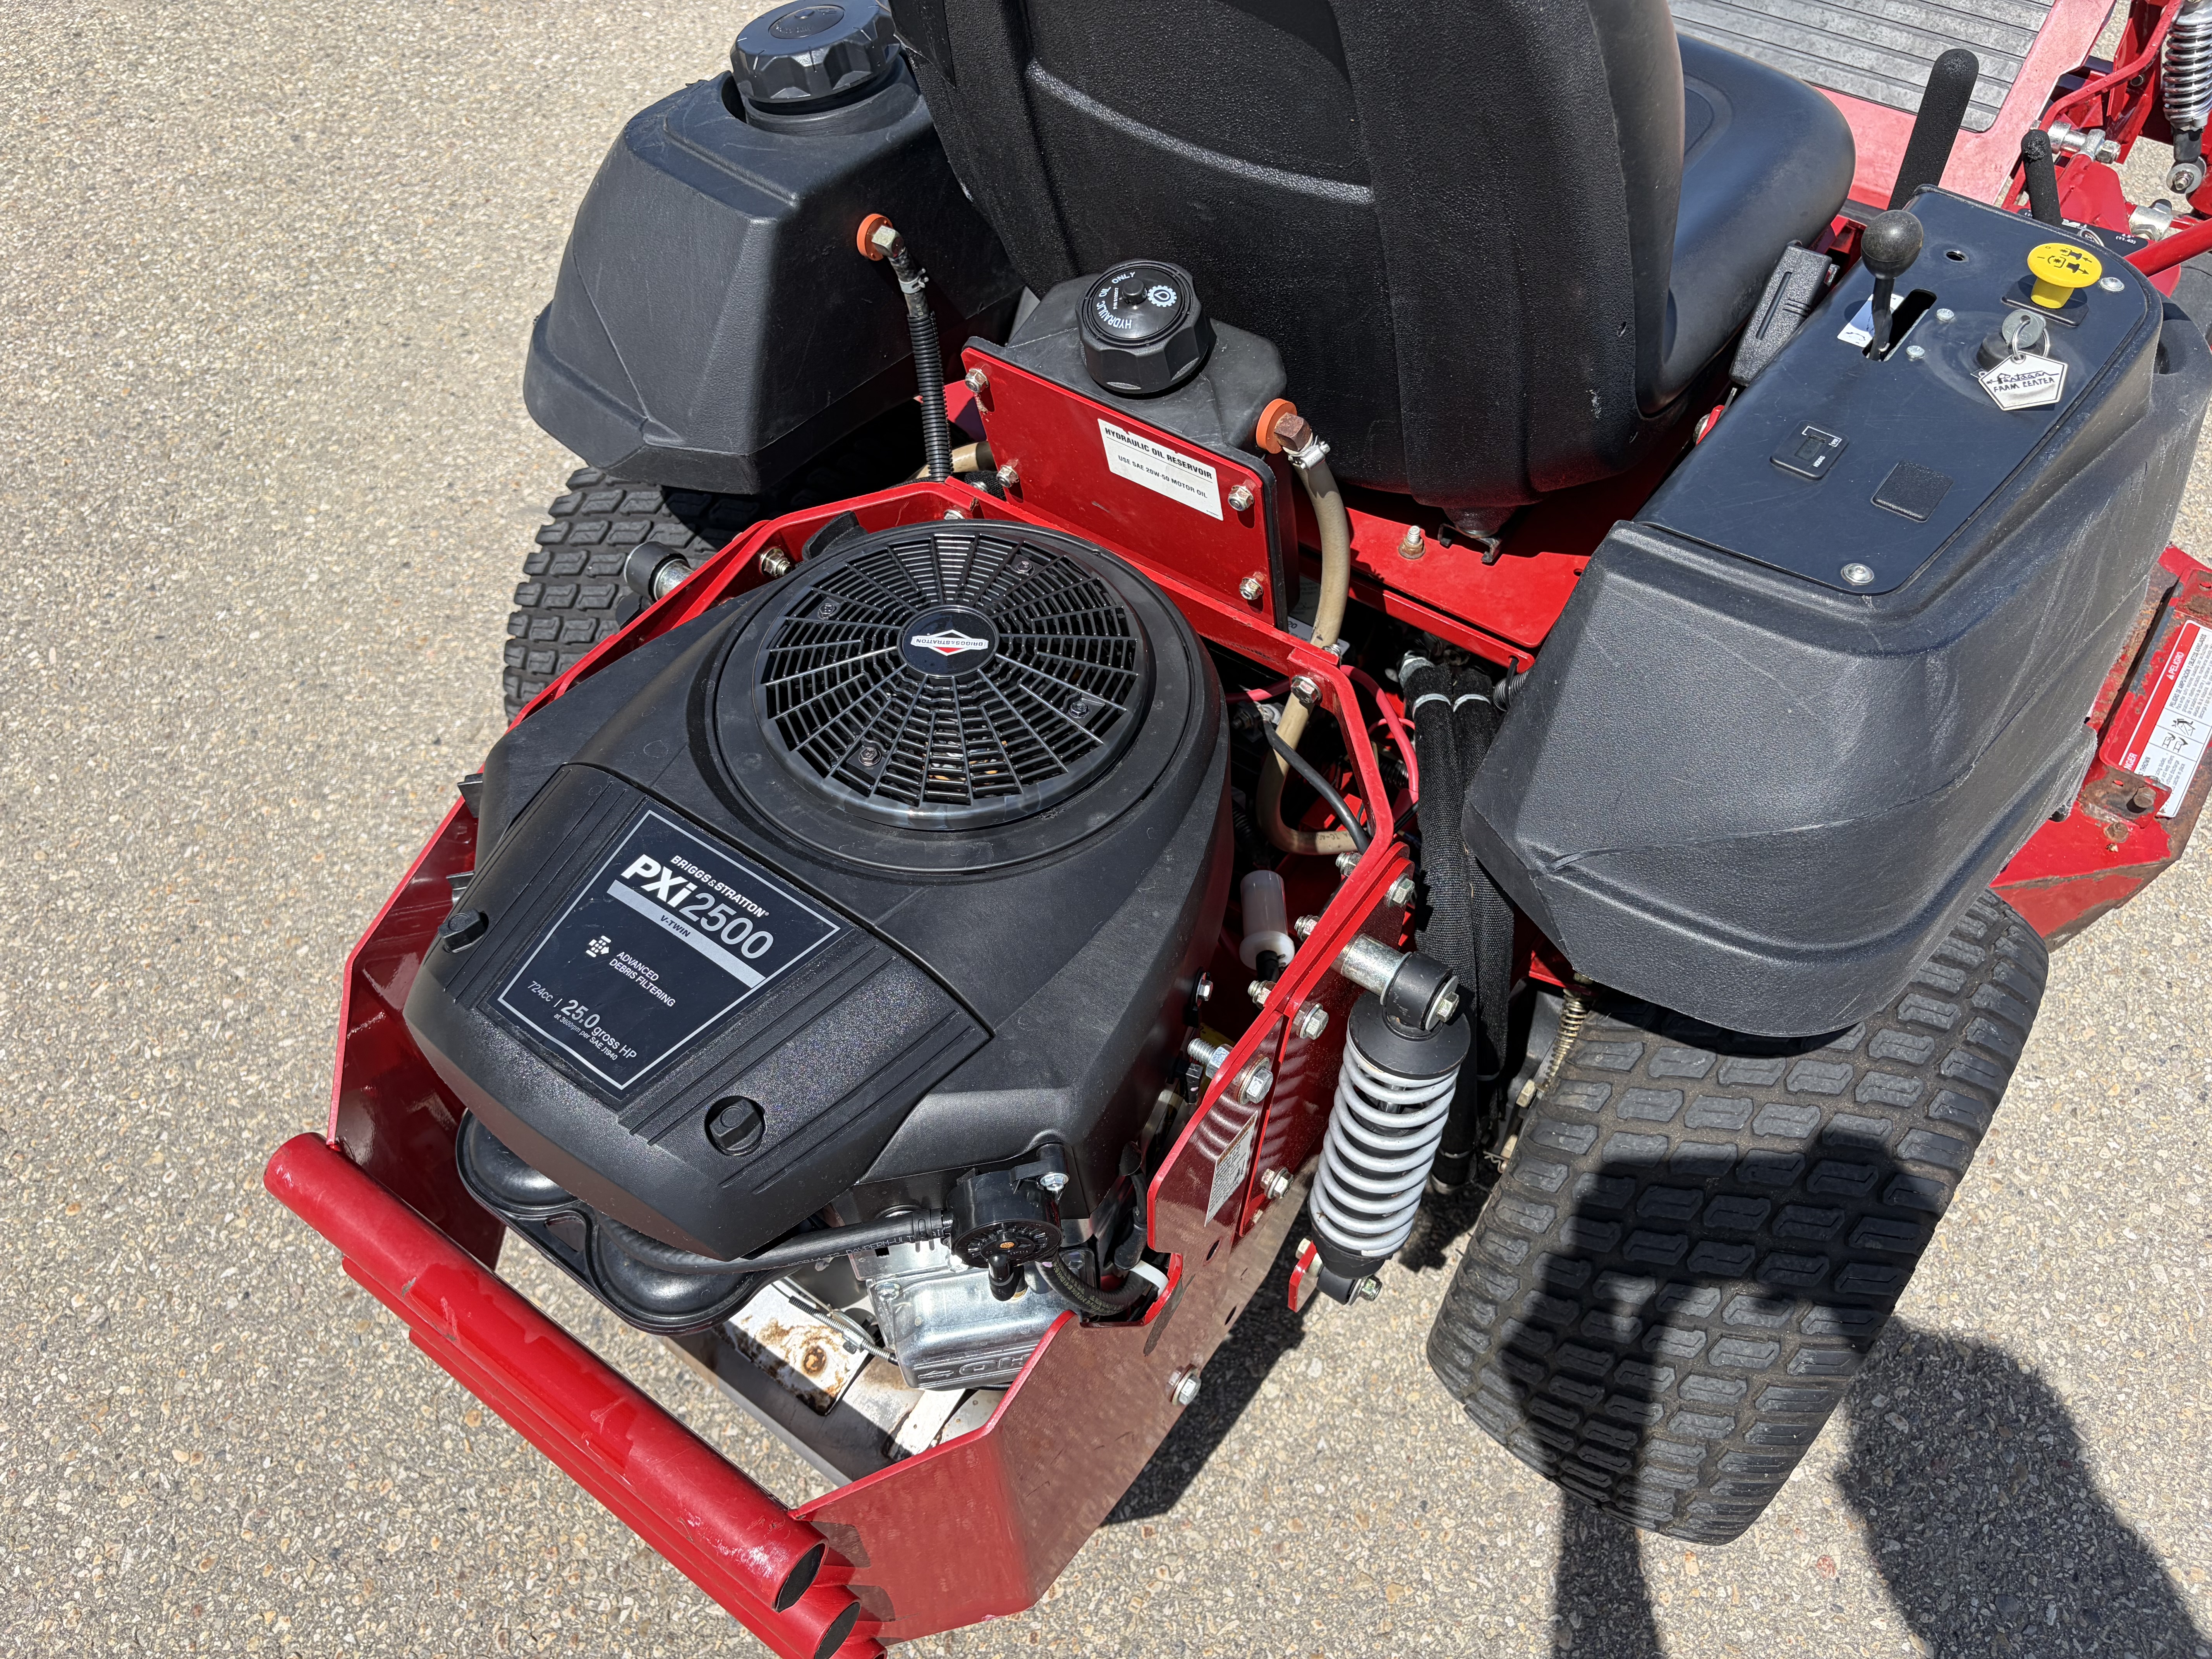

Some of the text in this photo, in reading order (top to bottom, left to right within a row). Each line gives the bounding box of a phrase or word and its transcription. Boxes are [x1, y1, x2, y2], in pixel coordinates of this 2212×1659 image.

[1096, 271, 1135, 329] HYDRAULIC OIL ONLY
[1105, 428, 1212, 479] HYDRAULIC OIL RESERVOIR
[1118, 455, 1207, 498] USE SAE 20W-50 MOTOR OIL
[2168, 651, 2185, 675] PELIGRO
[2123, 752, 2138, 770] NGER
[660, 915, 691, 937] V-TWIN
[609, 958, 676, 1007] DEBRIS FILTERING
[617, 951, 659, 981] ADVANCED
[527, 981, 637, 1058] 724cc 25.0 gross HP
[560, 1017, 581, 1033] 3600rpm
[580, 1030, 591, 1039] per
[589, 1036, 604, 1050] SAE
[601, 1046, 618, 1061] J1940
